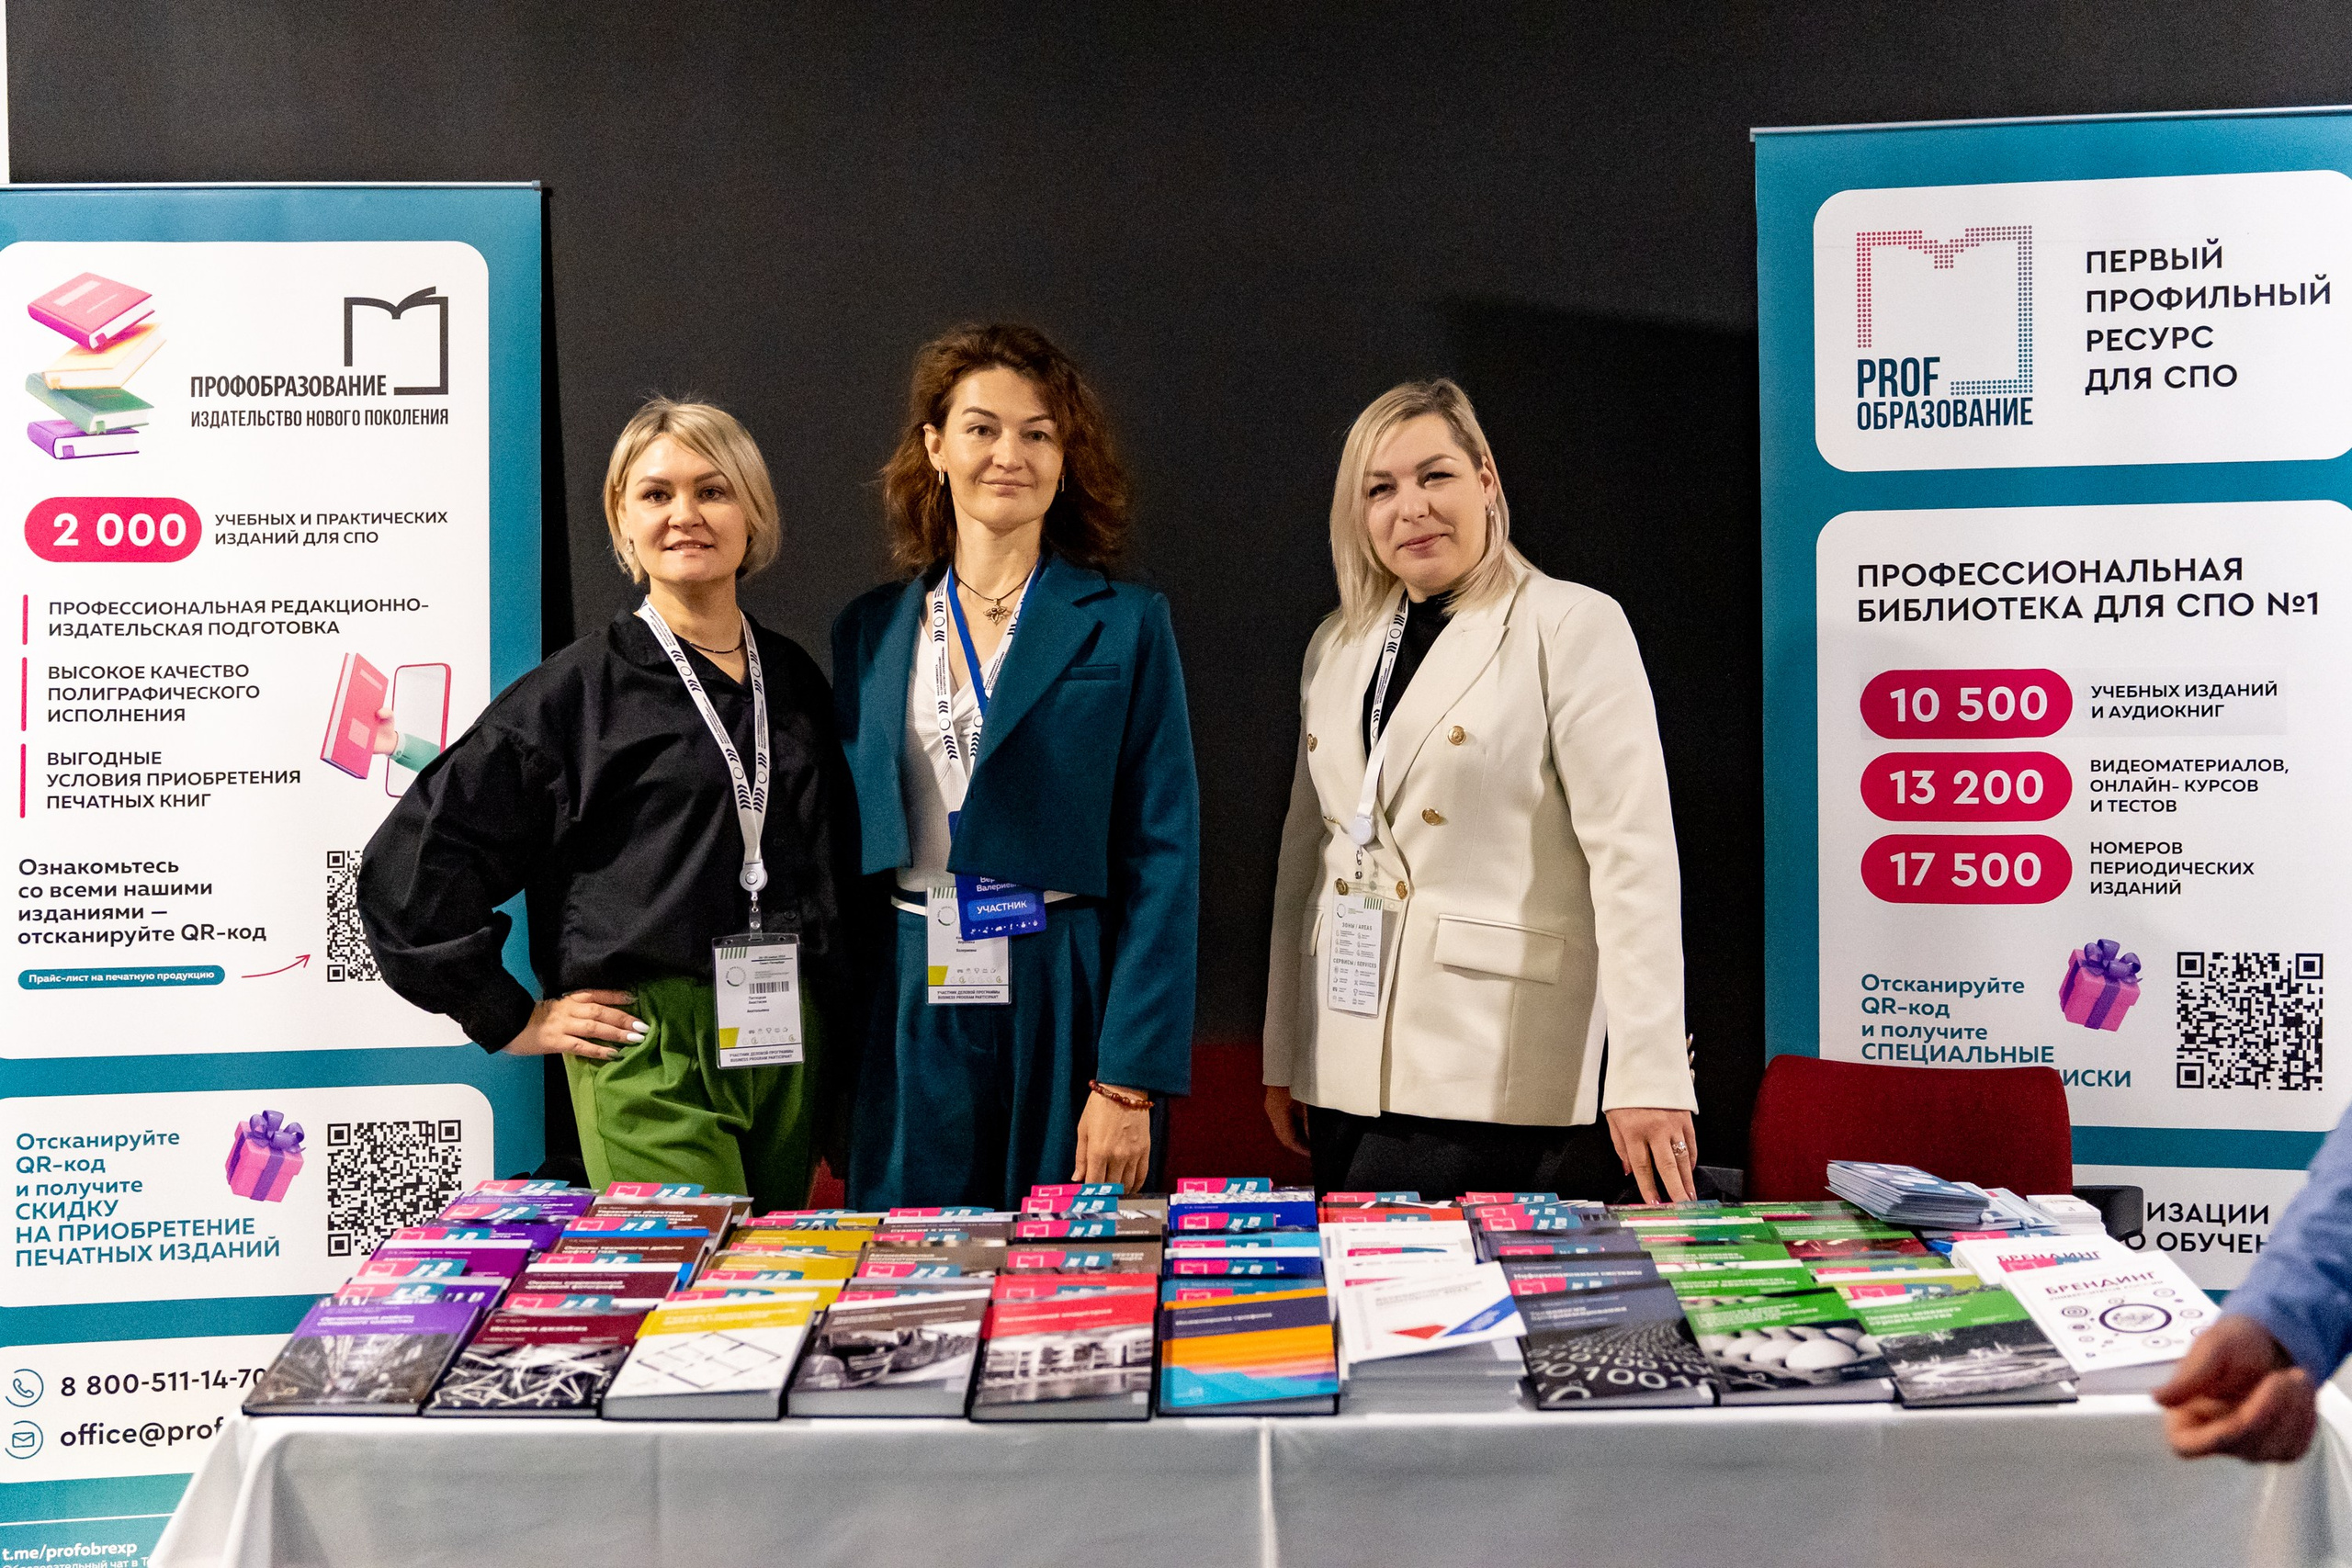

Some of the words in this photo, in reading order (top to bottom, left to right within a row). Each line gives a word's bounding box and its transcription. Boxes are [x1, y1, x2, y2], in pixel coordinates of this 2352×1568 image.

[2087, 238, 2222, 273] ПЕРВЫЙ
[2087, 274, 2330, 312] ПРОФИЛЬНЫЙ
[2087, 326, 2213, 352] РЕСУРС
[191, 375, 386, 397] ПРОФОБРАЗОВАНИЕ
[1857, 356, 1940, 398] PROF
[2086, 367, 2151, 395] ДЛЯ
[2165, 365, 2237, 389] СПО
[192, 411, 301, 428] ИЗДАТЕЛЬСТВО
[307, 410, 360, 426] НОВОГО
[365, 409, 447, 425] ПОКОЛЕНИЯ
[1857, 398, 2033, 431] ОБРАЗОВАНИЕ
[215, 514, 295, 525] УЧЕБНЫХ
[301, 514, 311, 525] И
[317, 512, 447, 525] ПРАКТИЧЕСКИХ
[53, 513, 78, 546] 2
[96, 513, 186, 547] 000
[216, 530, 298, 547] ИЗДАНИЙ
[303, 533, 338, 546] ДЛЯ
[344, 532, 379, 543] СПО
[1859, 558, 2242, 587] ПРОФЕССИОНАЛЬНАЯ
[50, 601, 265, 615] ПРОФЕССИОНАЛЬНАЯ
[272, 598, 428, 615] РЕДАКЦИОННО-
[1859, 595, 2083, 622] БИБЛИОТЕКА
[2095, 594, 2163, 623] ДЛЯ
[2177, 593, 2254, 617] СПО
[2268, 592, 2317, 615] №1
[50, 623, 202, 638] ИЗДАТЕЛЬСКАЯ
[209, 621, 339, 637] ПОДГОТОВКА
[49, 666, 144, 679] ВЫСОКОЕ
[152, 664, 249, 679] КАЧЕСТВО
[49, 685, 259, 701] ПОЛИГРАФИЧЕСКОГО
[2091, 685, 2179, 698] УЧЕБНЫХ
[2186, 681, 2277, 699] ИЗДАНИЙ
[1890, 688, 1939, 722] 10
[1958, 686, 2047, 721] 500
[2092, 706, 2103, 718] И
[2109, 705, 2224, 720] АУДИОКНИГ
[49, 708, 185, 722] ИСПОЛНЕНИЯ
[48, 751, 161, 767] ВЫГОДНЫЕ
[2091, 759, 2288, 774] ВИДЕОМАТЕРИАЛОВ,
[47, 773, 141, 787] УСЛОВИЯ
[147, 771, 300, 785] ПРИОБРЕТЕНИЯ
[1890, 771, 1935, 804] 13
[1953, 770, 2043, 804] 200
[2090, 777, 2178, 792] ОНЛАЙН-
[2186, 780, 2258, 792] КУРСОВ
[48, 795, 154, 808] ПЕЧАТНЫХ
[161, 794, 210, 807] КНИГ
[2091, 800, 2102, 812] И
[2108, 800, 2177, 812] ТЕСТОВ
[2091, 841, 2182, 854] НОМЕРОВ
[19, 859, 178, 875] Ознакомьтесь
[1890, 852, 1935, 886] 17
[1951, 852, 2041, 886] 500
[2091, 862, 2254, 876] ПЕРИОДИЧЕСКИХ
[18, 886, 42, 898] со
[51, 886, 116, 897] всеми
[124, 884, 211, 896] нашими
[2091, 880, 2180, 897] ИЗДАНИЙ
[19, 908, 143, 923] изданиями
[977, 900, 1027, 915] УЧАСТНИК
[18, 926, 175, 947] отсканируйте
[181, 924, 266, 942] QR-код
[29, 975, 89, 985] Прайс-лист
[106, 974, 154, 982] печатную
[157, 972, 214, 981] продукцию
[1861, 974, 2024, 998] Отсканируйте
[1861, 997, 1950, 1019] QR-код
[1862, 1025, 1873, 1036] и
[1882, 1025, 1987, 1043] получите
[1861, 1043, 2054, 1065] СПЕЦИАЛЬНЫЕ
[2059, 1069, 2132, 1088] ИСКИ
[17, 1130, 179, 1151] Отсканируйте
[17, 1156, 105, 1174] QR-код
[17, 1185, 28, 1196] и
[37, 1180, 142, 1200] получите
[16, 1200, 119, 1222] СКИДКУ
[2147, 1202, 2269, 1227] ИЗАЦИИ
[17, 1226, 51, 1243] НА
[59, 1218, 254, 1242] ПРИОБРЕТЕНИЕ
[17, 1245, 153, 1267] ПЕЧАТНЫХ
[160, 1236, 279, 1263] ИЗДАНИЙ
[2045, 1271, 2157, 1295] БРЕНДИНГ
[61, 1377, 76, 1397] 8
[2, 1542, 137, 1562] t.me/profobrexp
